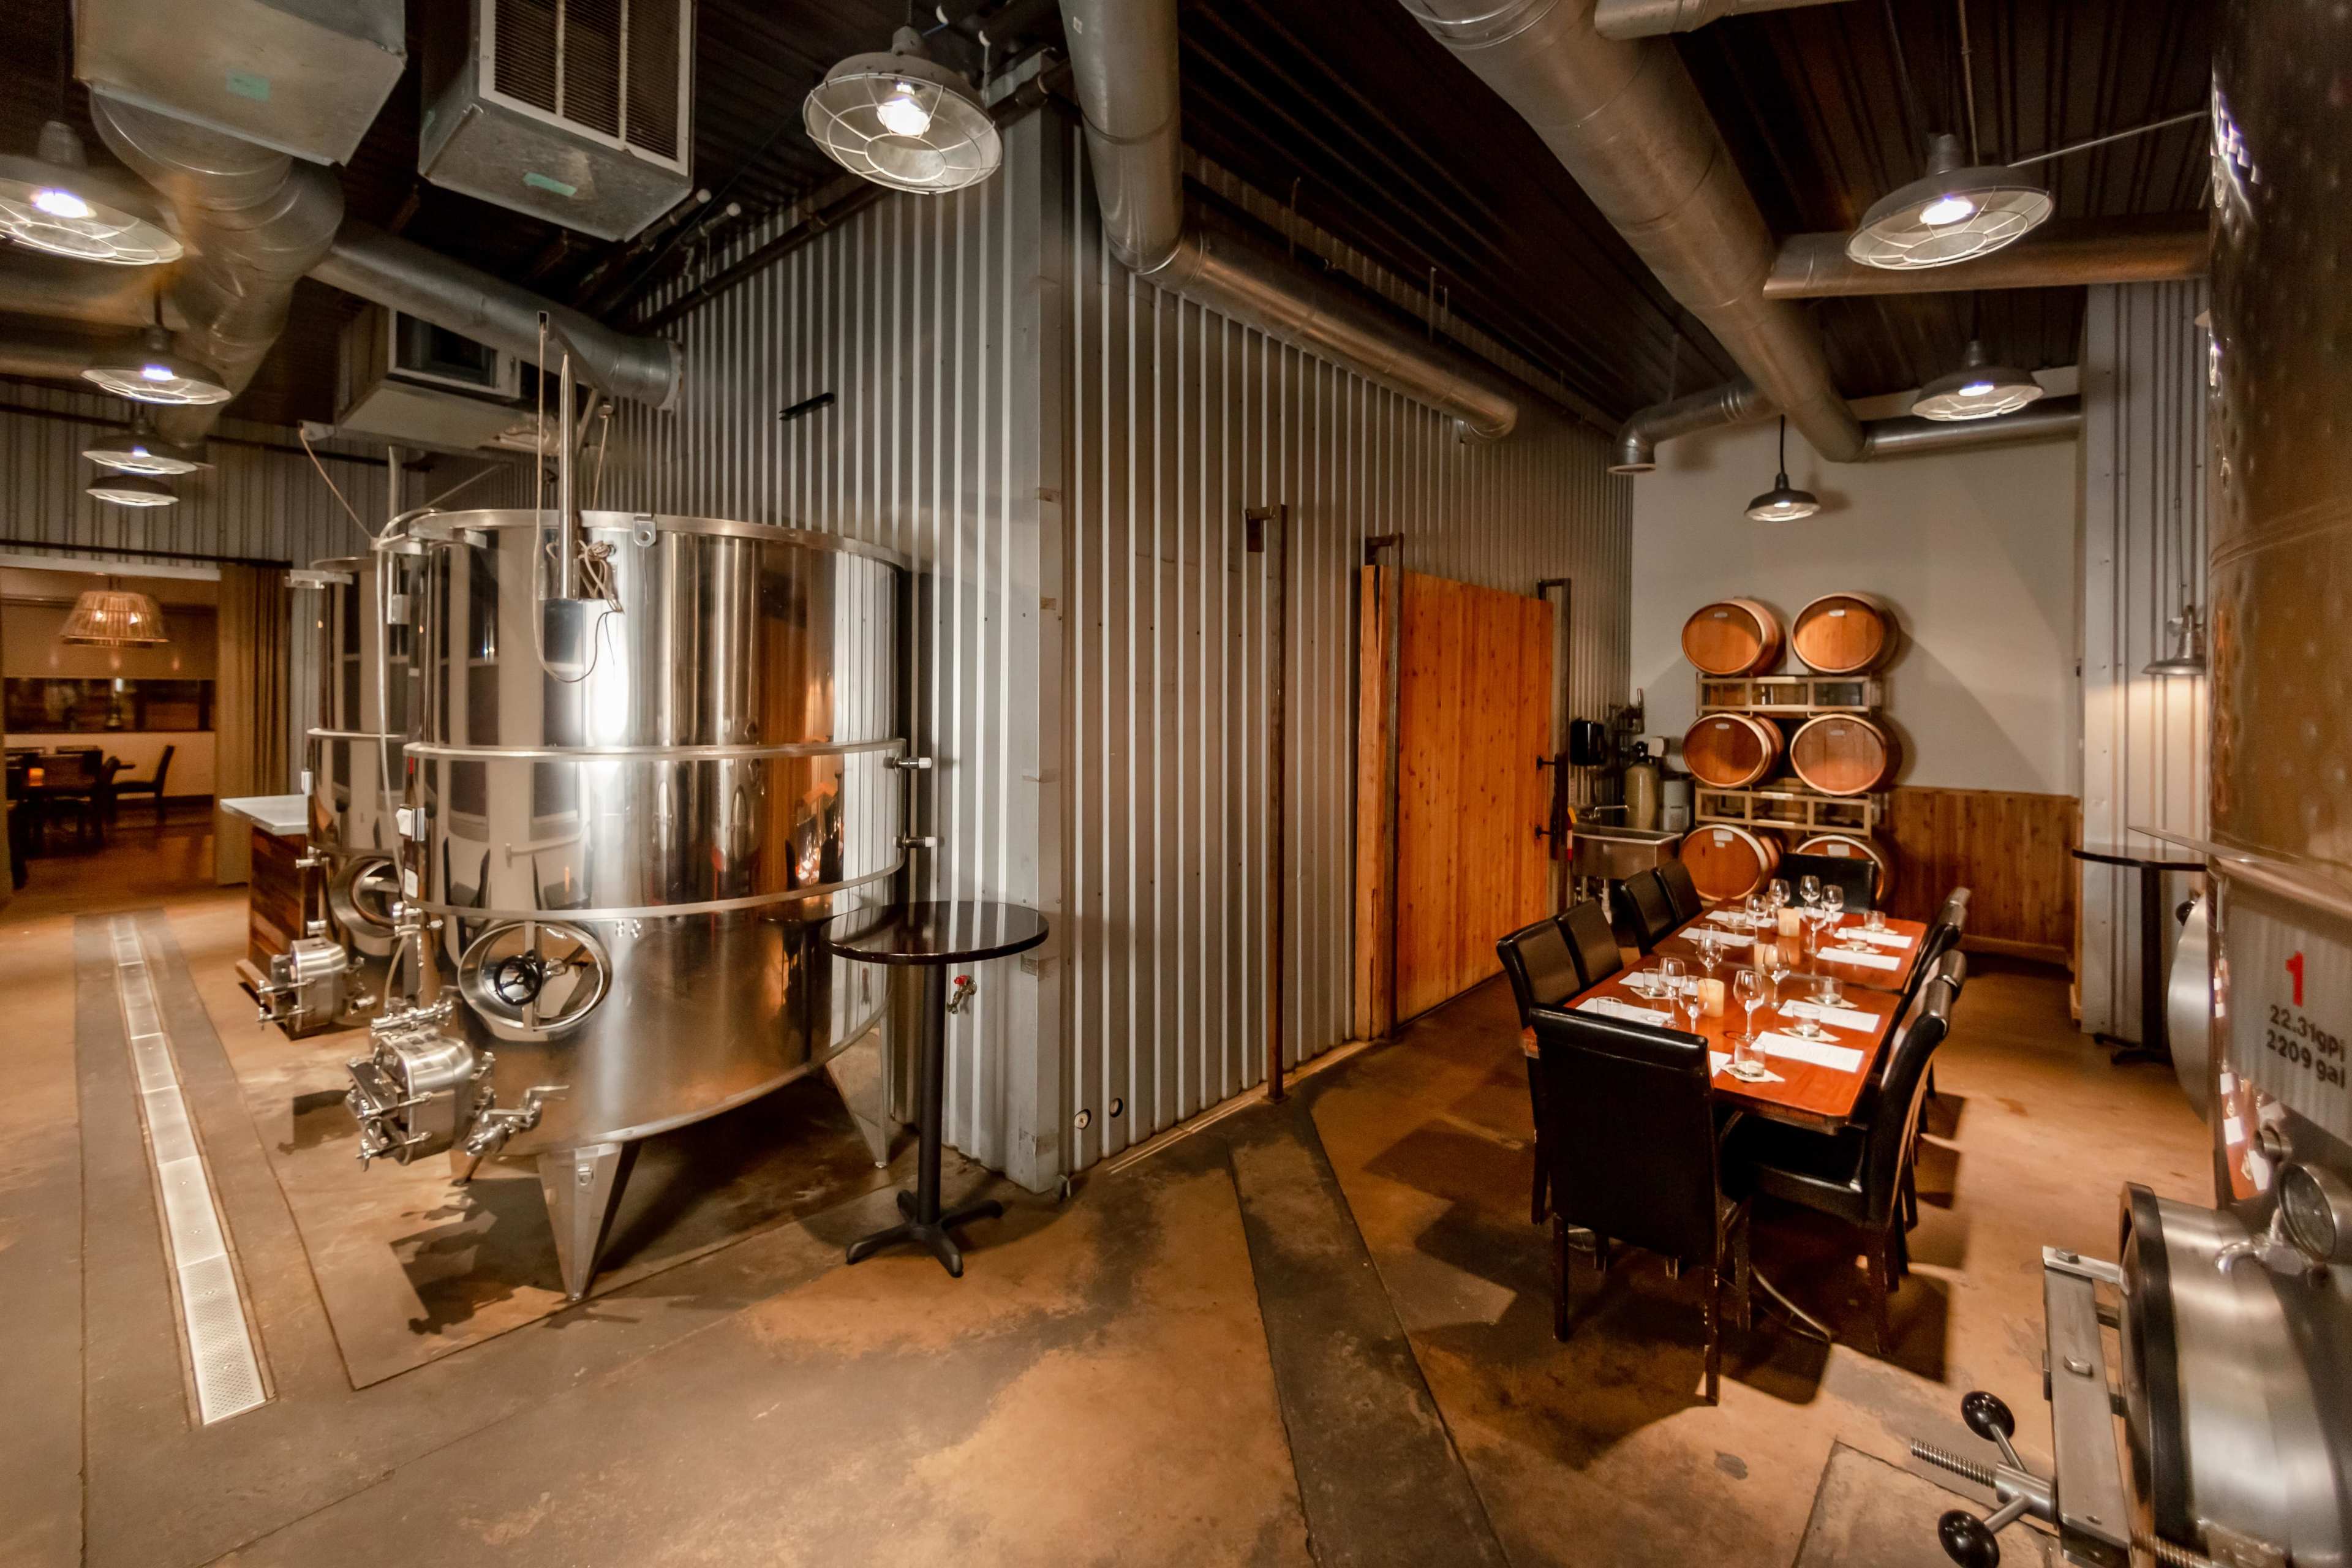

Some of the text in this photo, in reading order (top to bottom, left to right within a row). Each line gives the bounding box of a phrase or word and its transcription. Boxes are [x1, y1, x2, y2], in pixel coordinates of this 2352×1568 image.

[2285, 951, 2304, 1008] 1
[2266, 1029, 2345, 1088] 2209 gal
